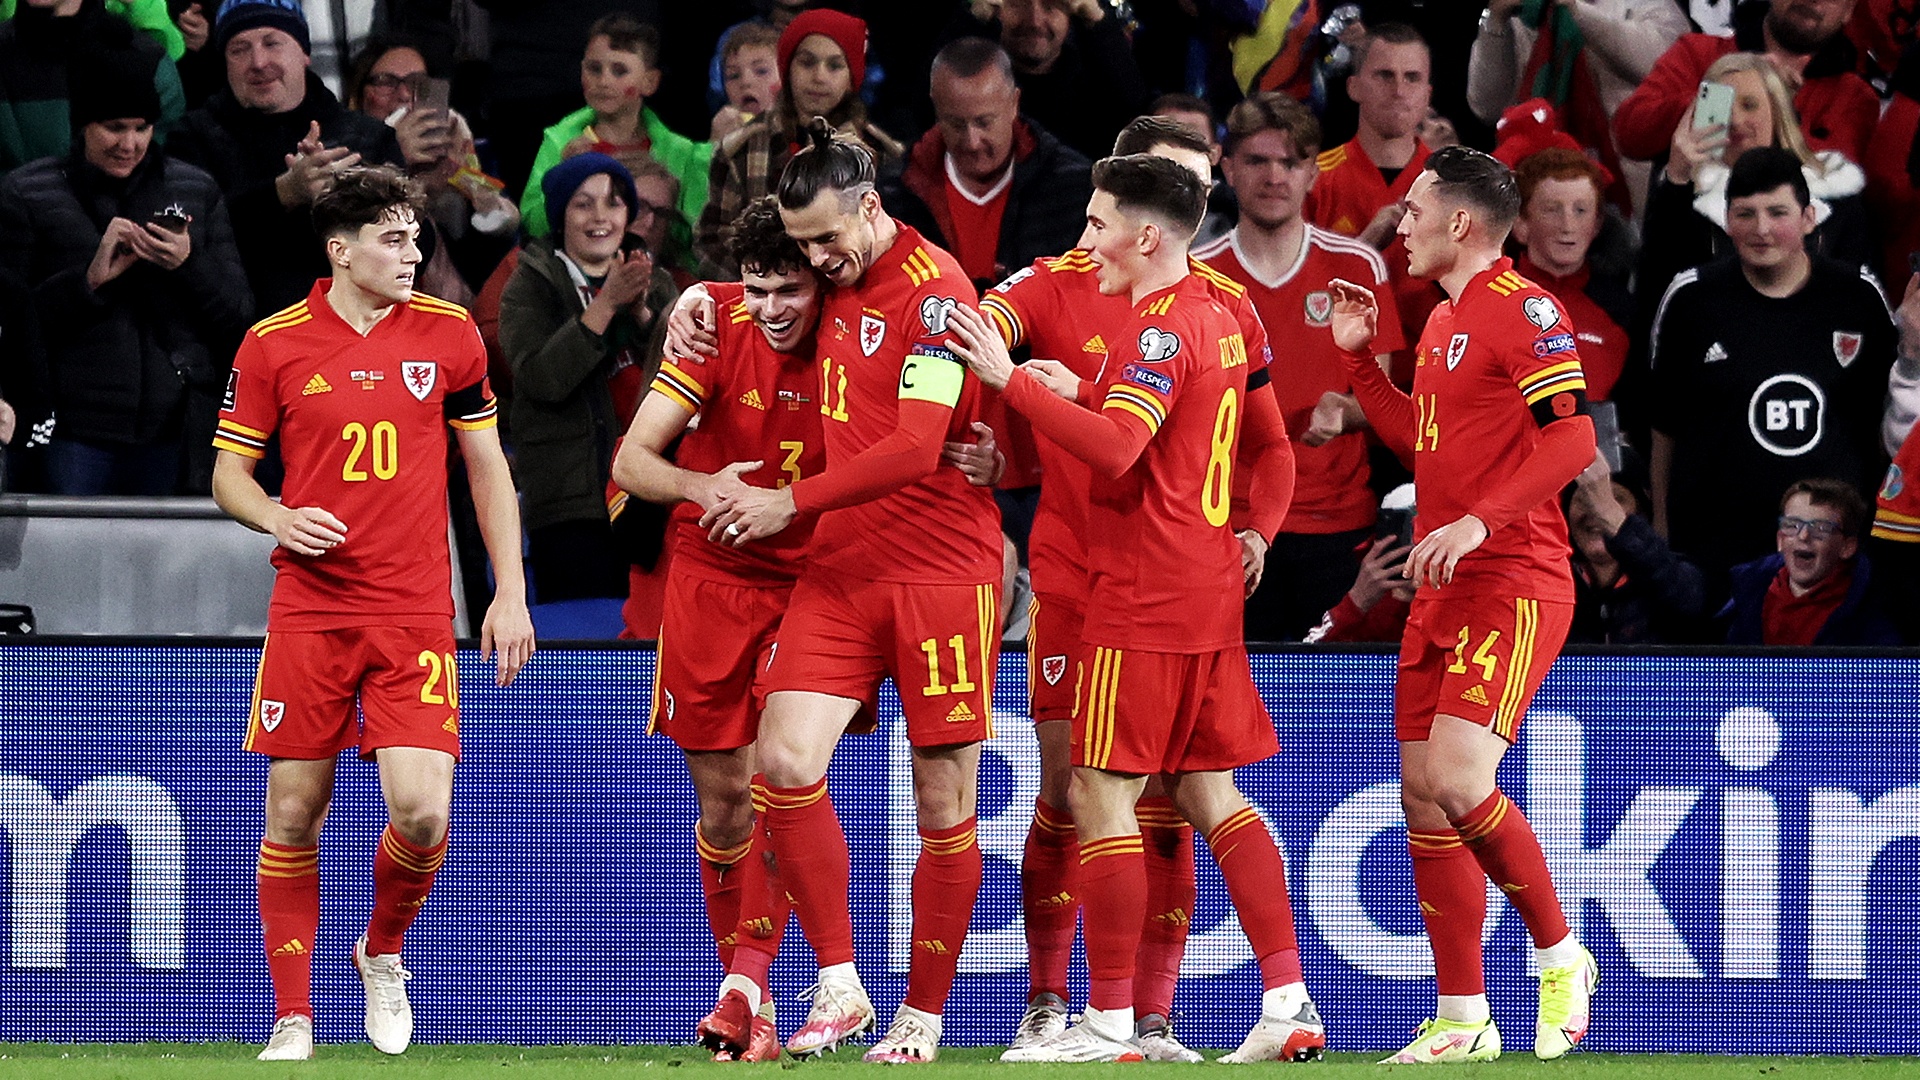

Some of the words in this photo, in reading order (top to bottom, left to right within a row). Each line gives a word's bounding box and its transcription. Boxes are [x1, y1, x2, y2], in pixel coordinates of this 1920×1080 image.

[901, 363, 918, 389] C
[924, 349, 956, 361] RESPE
[1136, 371, 1172, 391] RESPECT
[820, 357, 849, 422] 11
[1766, 400, 1810, 431] BT
[342, 420, 398, 482] 20
[1415, 394, 1439, 452] 14
[777, 440, 804, 490] 3
[1201, 387, 1238, 528] 8
[418, 650, 459, 709] 20
[920, 633, 975, 697] 11
[1447, 625, 1501, 682] 14
